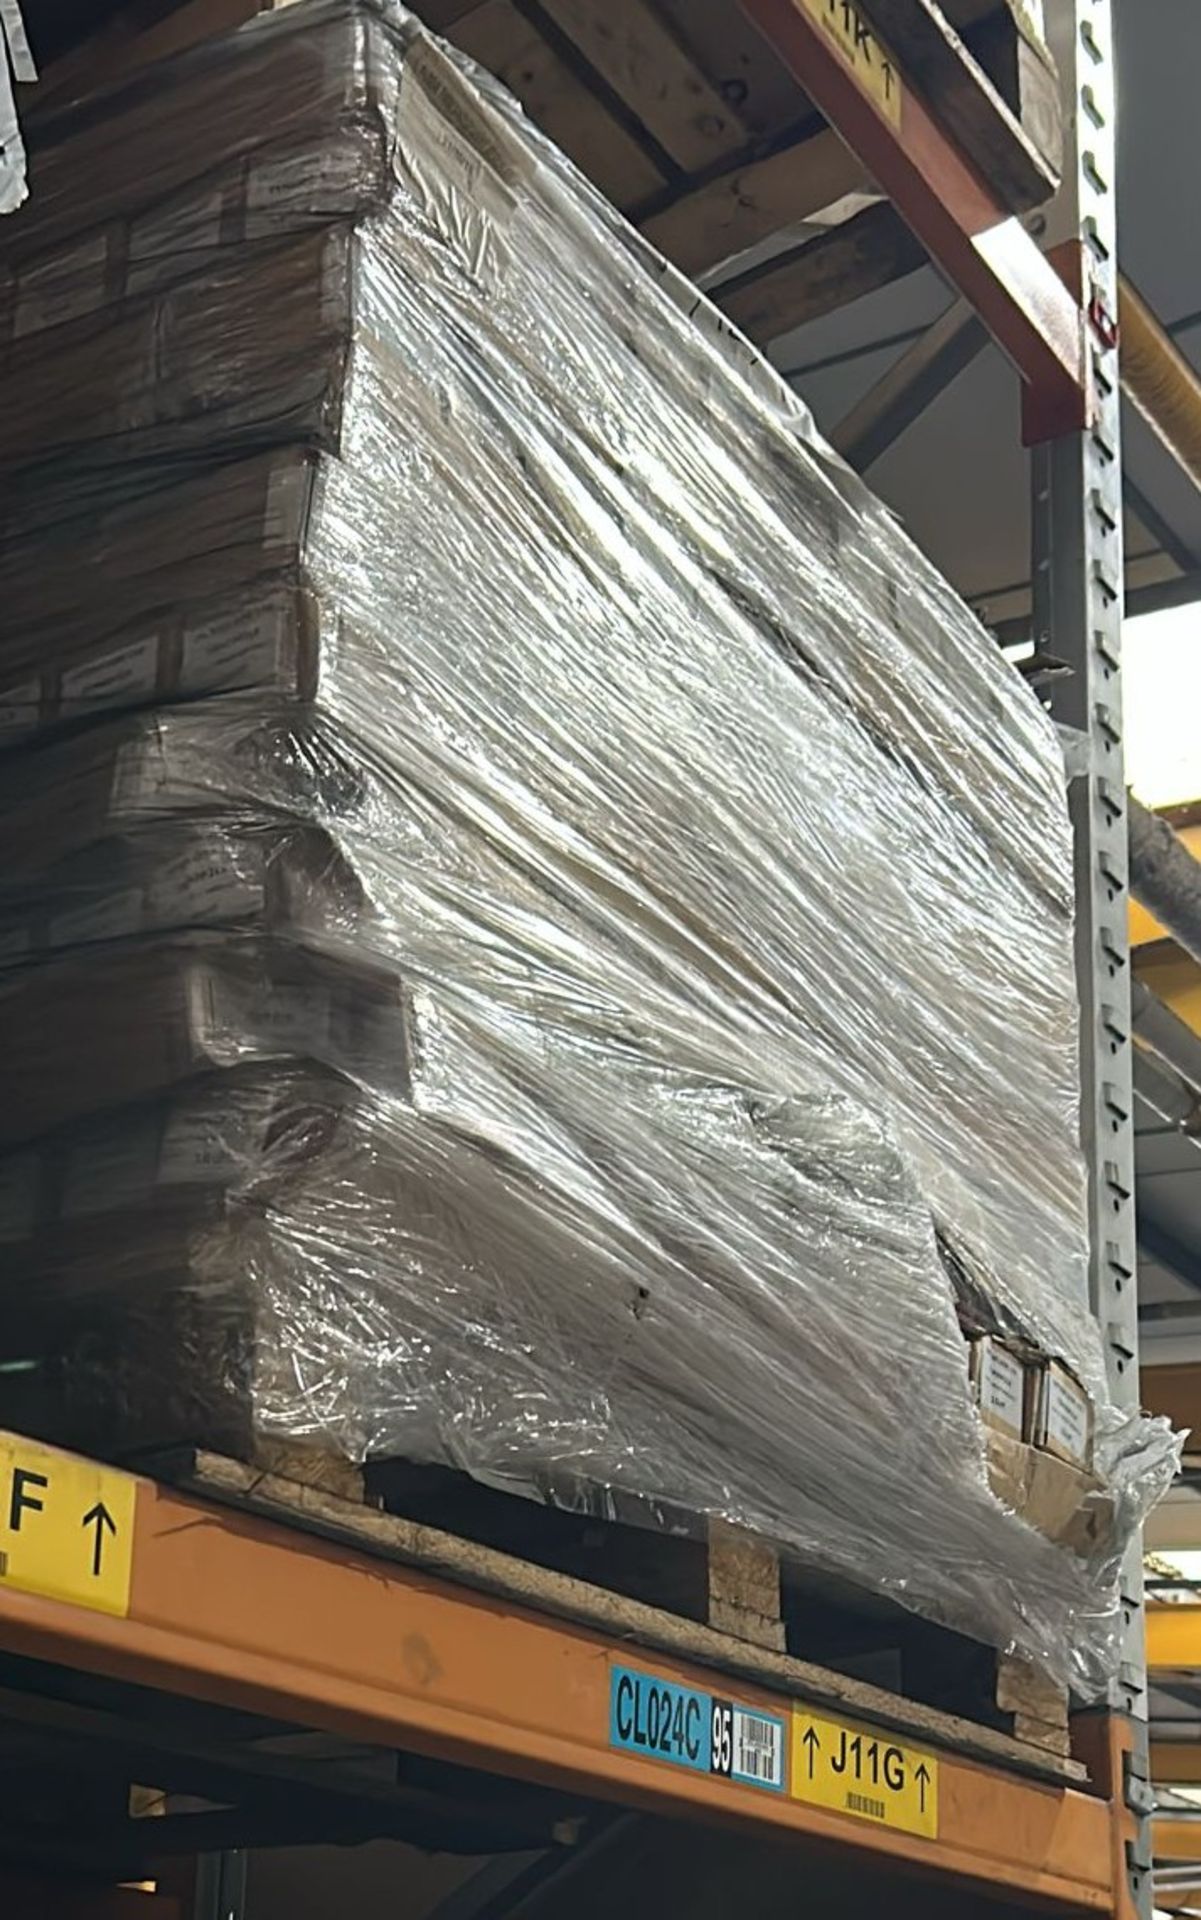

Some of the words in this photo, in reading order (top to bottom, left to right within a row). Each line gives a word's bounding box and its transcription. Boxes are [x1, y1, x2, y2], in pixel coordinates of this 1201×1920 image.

[616, 1675, 700, 1761] CL024C
[712, 1706, 731, 1773] 95
[831, 1731, 904, 1791] J11G
